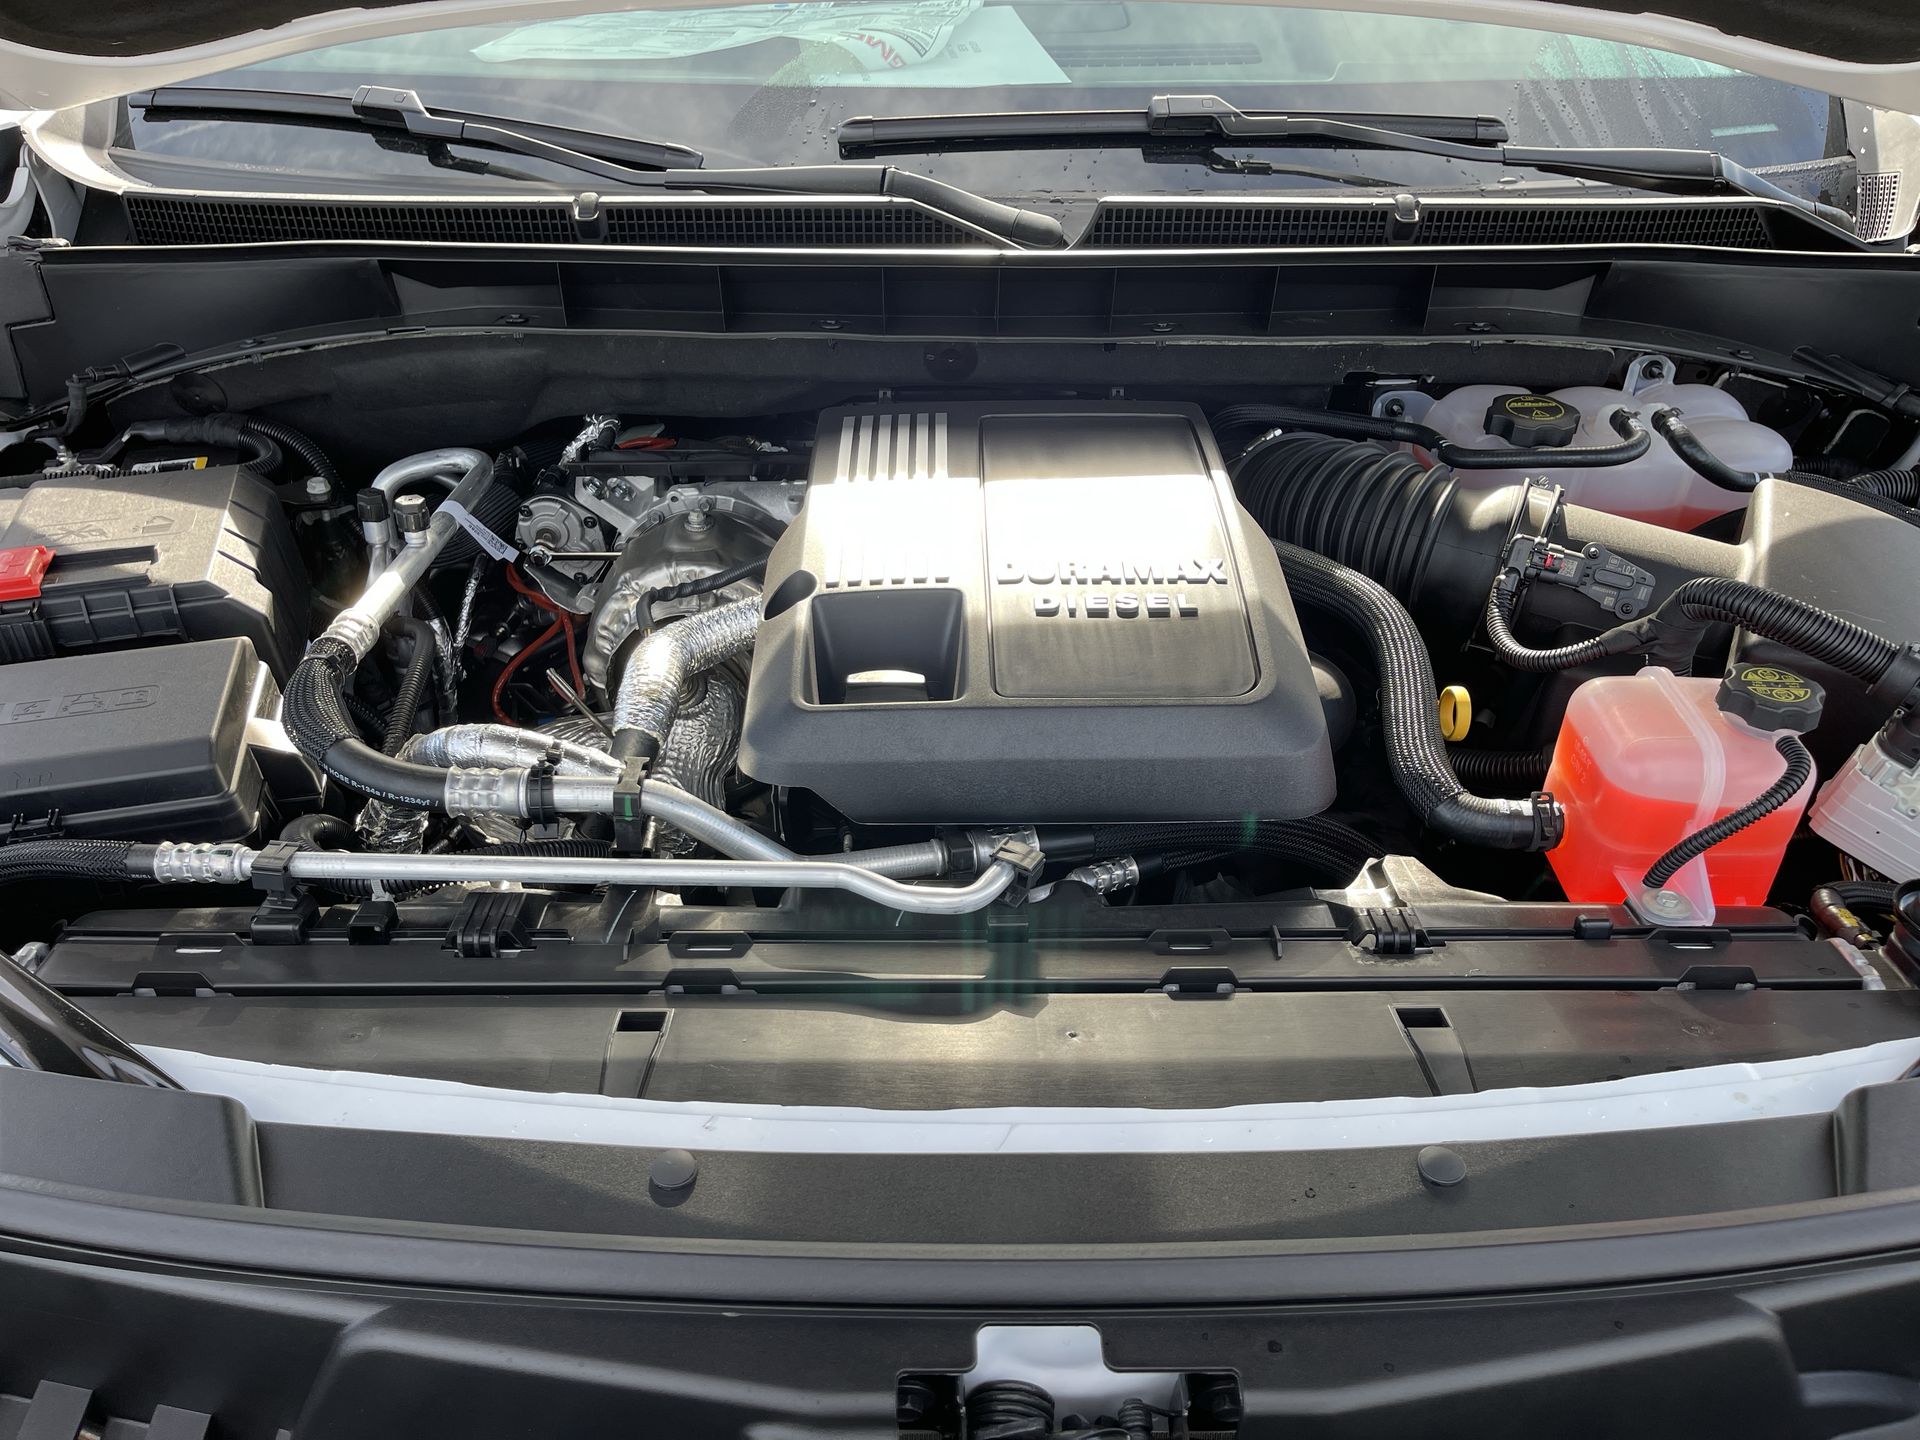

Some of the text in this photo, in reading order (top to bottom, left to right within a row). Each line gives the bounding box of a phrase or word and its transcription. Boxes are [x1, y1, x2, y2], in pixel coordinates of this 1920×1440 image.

[996, 558, 1228, 585] DURAMAX
[1033, 592, 1199, 619] DIESEL
[329, 768, 350, 785] HOSE
[387, 792, 431, 807] R-1234yf
